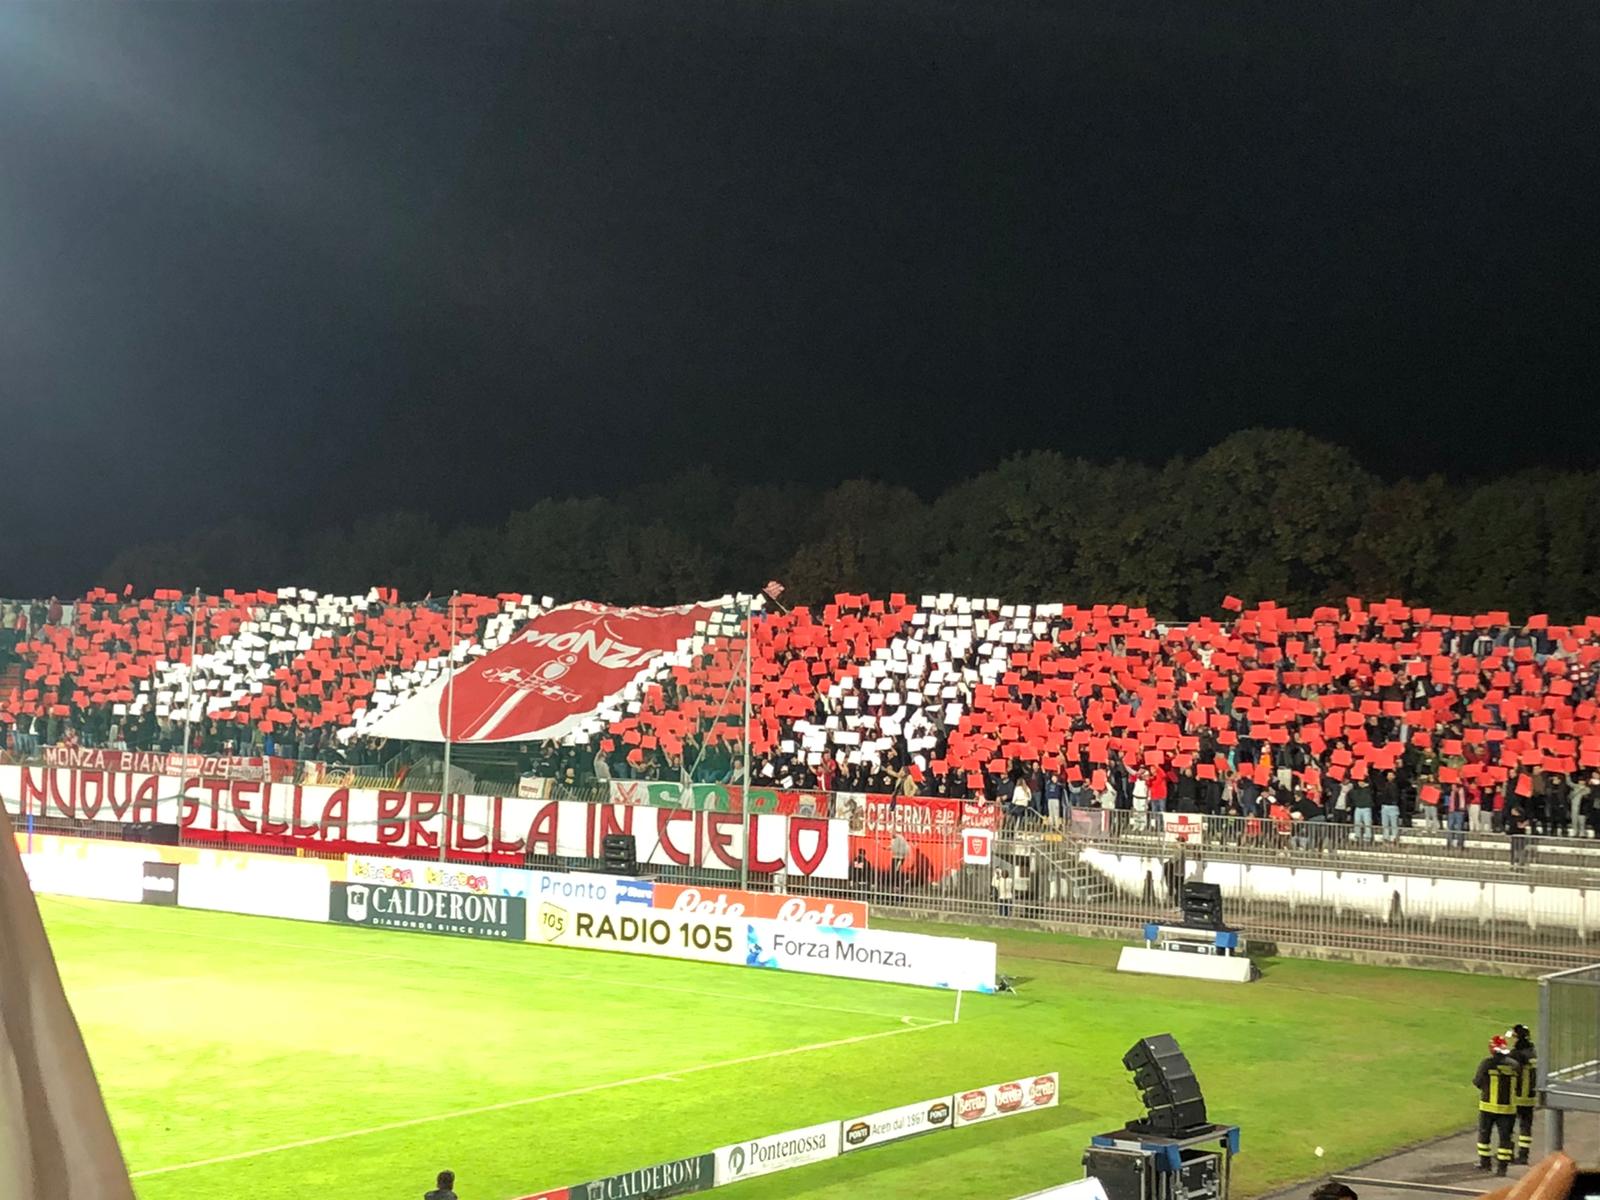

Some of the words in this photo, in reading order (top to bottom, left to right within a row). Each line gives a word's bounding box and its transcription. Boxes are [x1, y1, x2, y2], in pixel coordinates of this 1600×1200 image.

[46, 748, 105, 769] MONZA
[20, 766, 159, 823] NUOVA
[182, 776, 349, 841] STELLA
[377, 790, 559, 856] BRILLA
[586, 802, 633, 860] IN
[657, 806, 828, 876] CIELO
[867, 803, 931, 834] CEDERNA
[541, 876, 606, 899] Pronto
[372, 886, 508, 924] CALDERONI
[543, 912, 564, 931] 105
[373, 917, 432, 930] DIAMONDS
[438, 922, 474, 934] SINCE
[576, 913, 671, 945] RADIO
[680, 923, 732, 952] 105
[773, 934, 829, 958] Forza
[836, 940, 912, 968] Monza.
[750, 1132, 826, 1165] Pontenossa
[608, 1157, 700, 1200] CALDERONI
